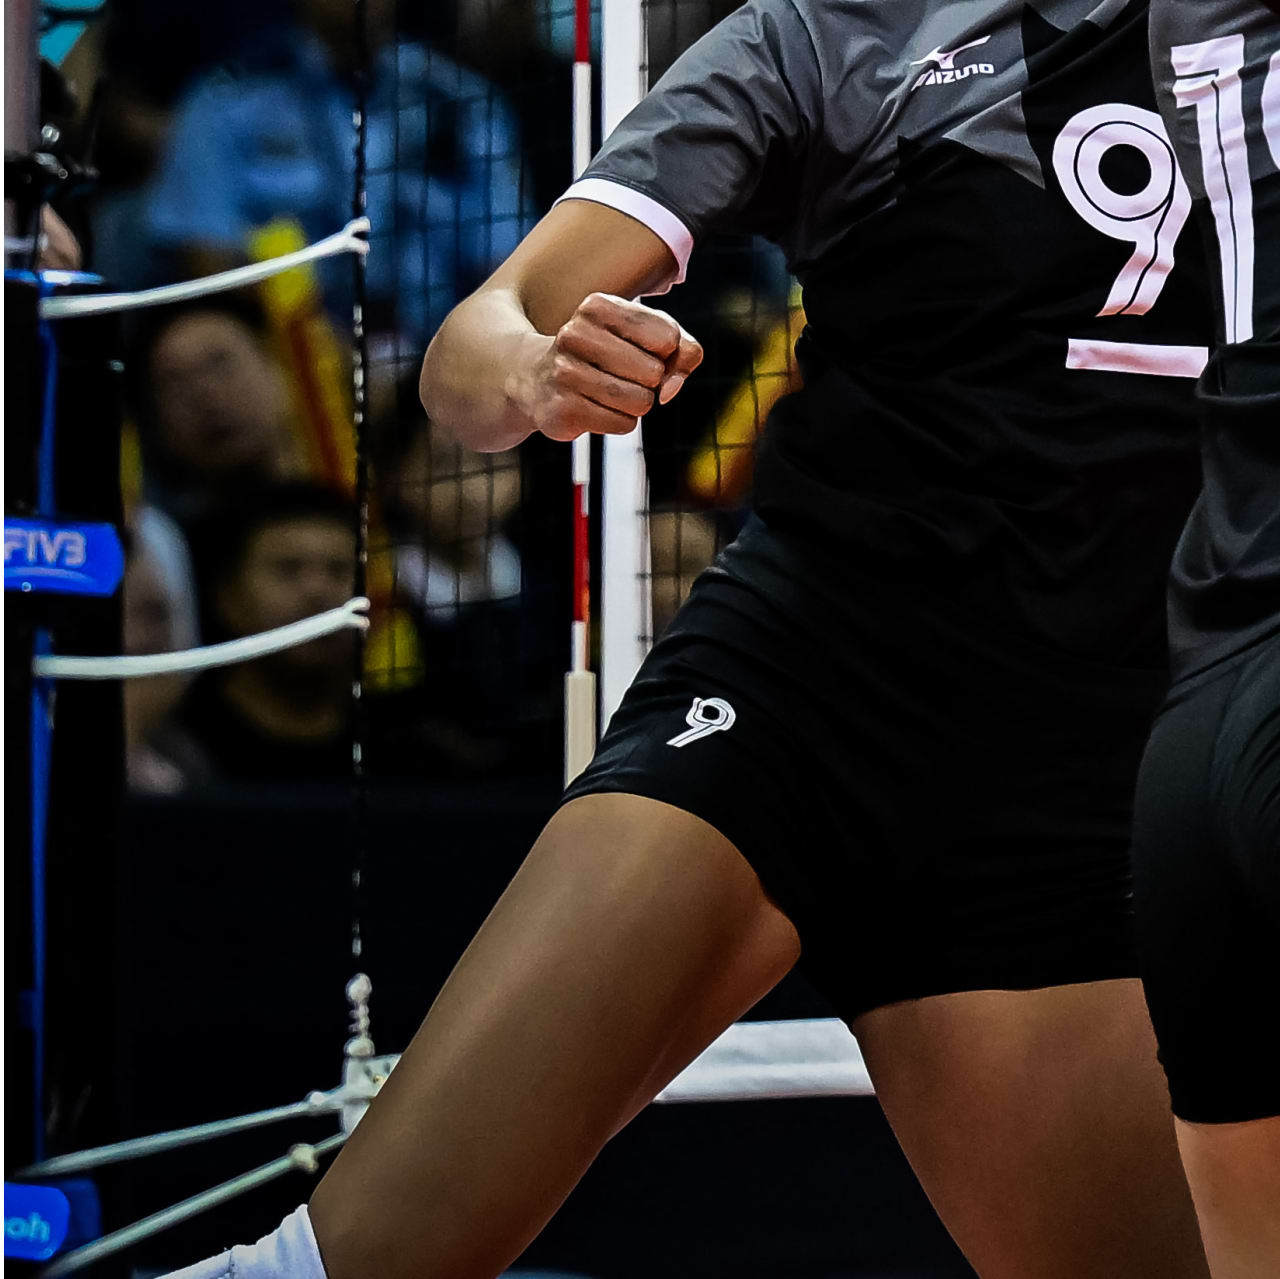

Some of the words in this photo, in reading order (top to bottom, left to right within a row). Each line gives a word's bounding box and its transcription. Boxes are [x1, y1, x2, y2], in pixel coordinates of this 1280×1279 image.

[911, 64, 994, 92] MIZUNO
[1053, 103, 1191, 317] 9
[4, 527, 86, 566] FIVB
[666, 697, 736, 748] 9
